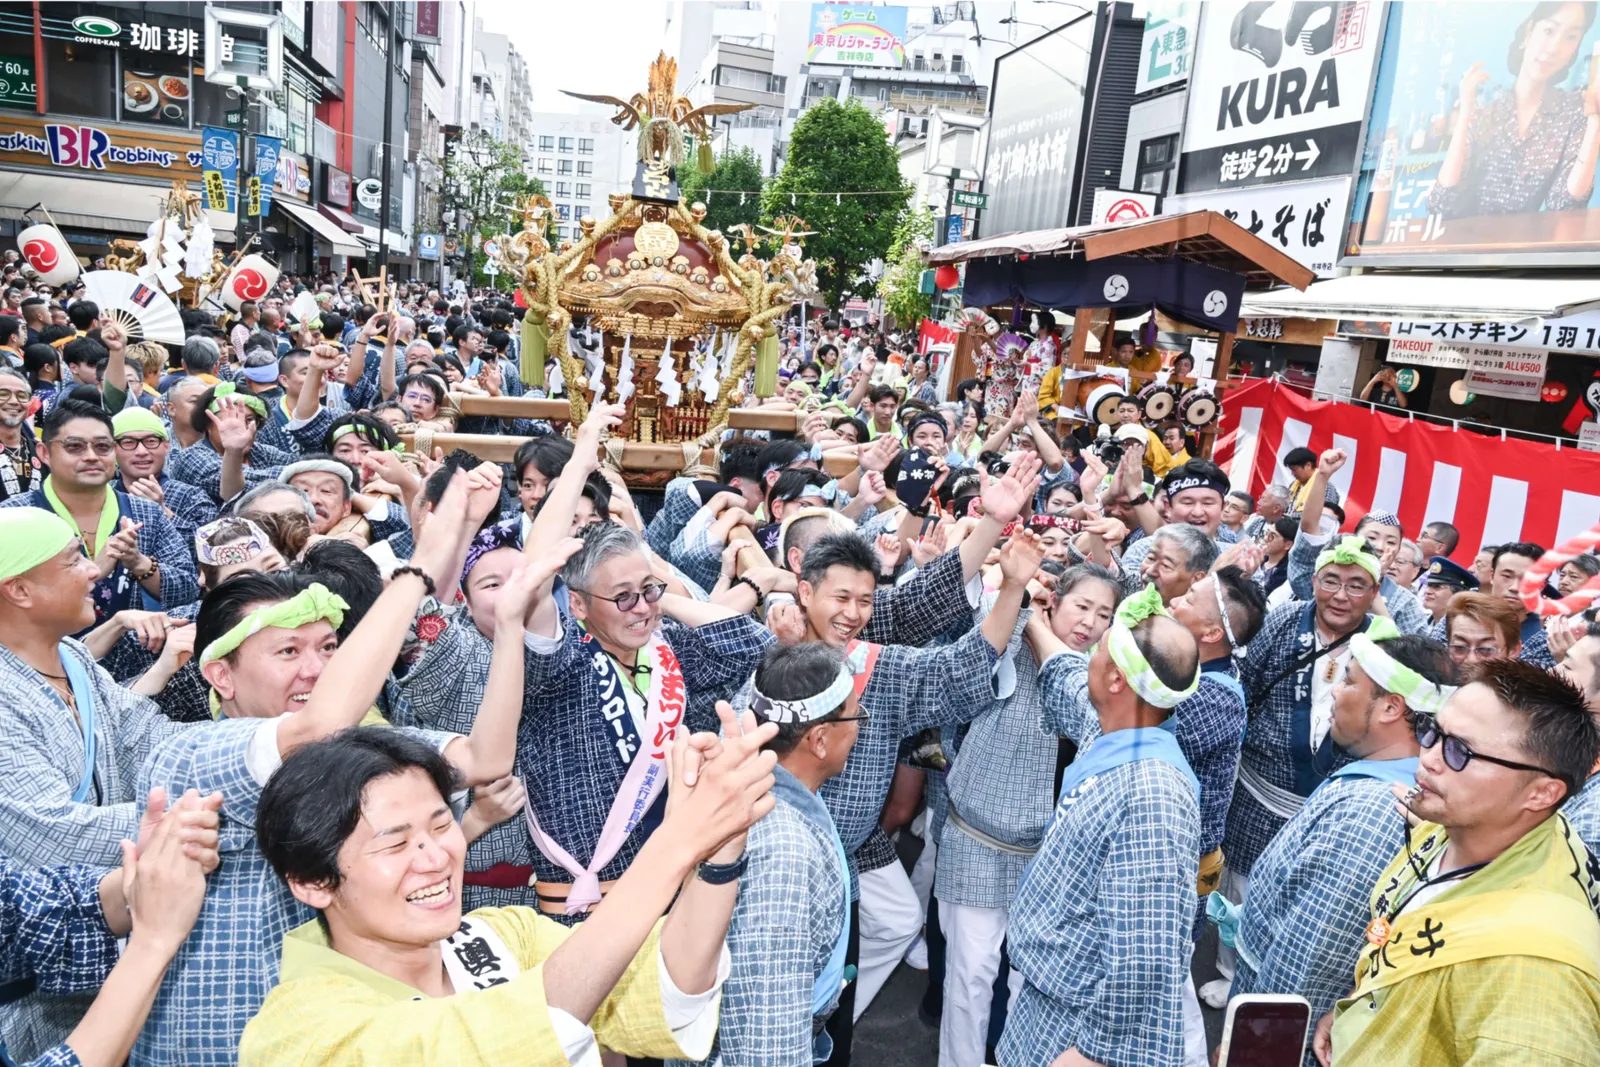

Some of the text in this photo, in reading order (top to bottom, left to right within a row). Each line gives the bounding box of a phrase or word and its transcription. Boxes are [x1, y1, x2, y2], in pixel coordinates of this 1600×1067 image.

[842, 10, 876, 22] ゲーム
[813, 34, 901, 51] 東京レジャーランド
[1216, 59, 1340, 132] KURA
[1220, 142, 1294, 182] 徒歩2分
[958, 193, 984, 206] 平和通り
[1384, 212, 1446, 244] ボール
[1392, 339, 1433, 353] TAKEOUT
[593, 651, 637, 764] サンロード
[623, 762, 660, 834] 副実行委員長
